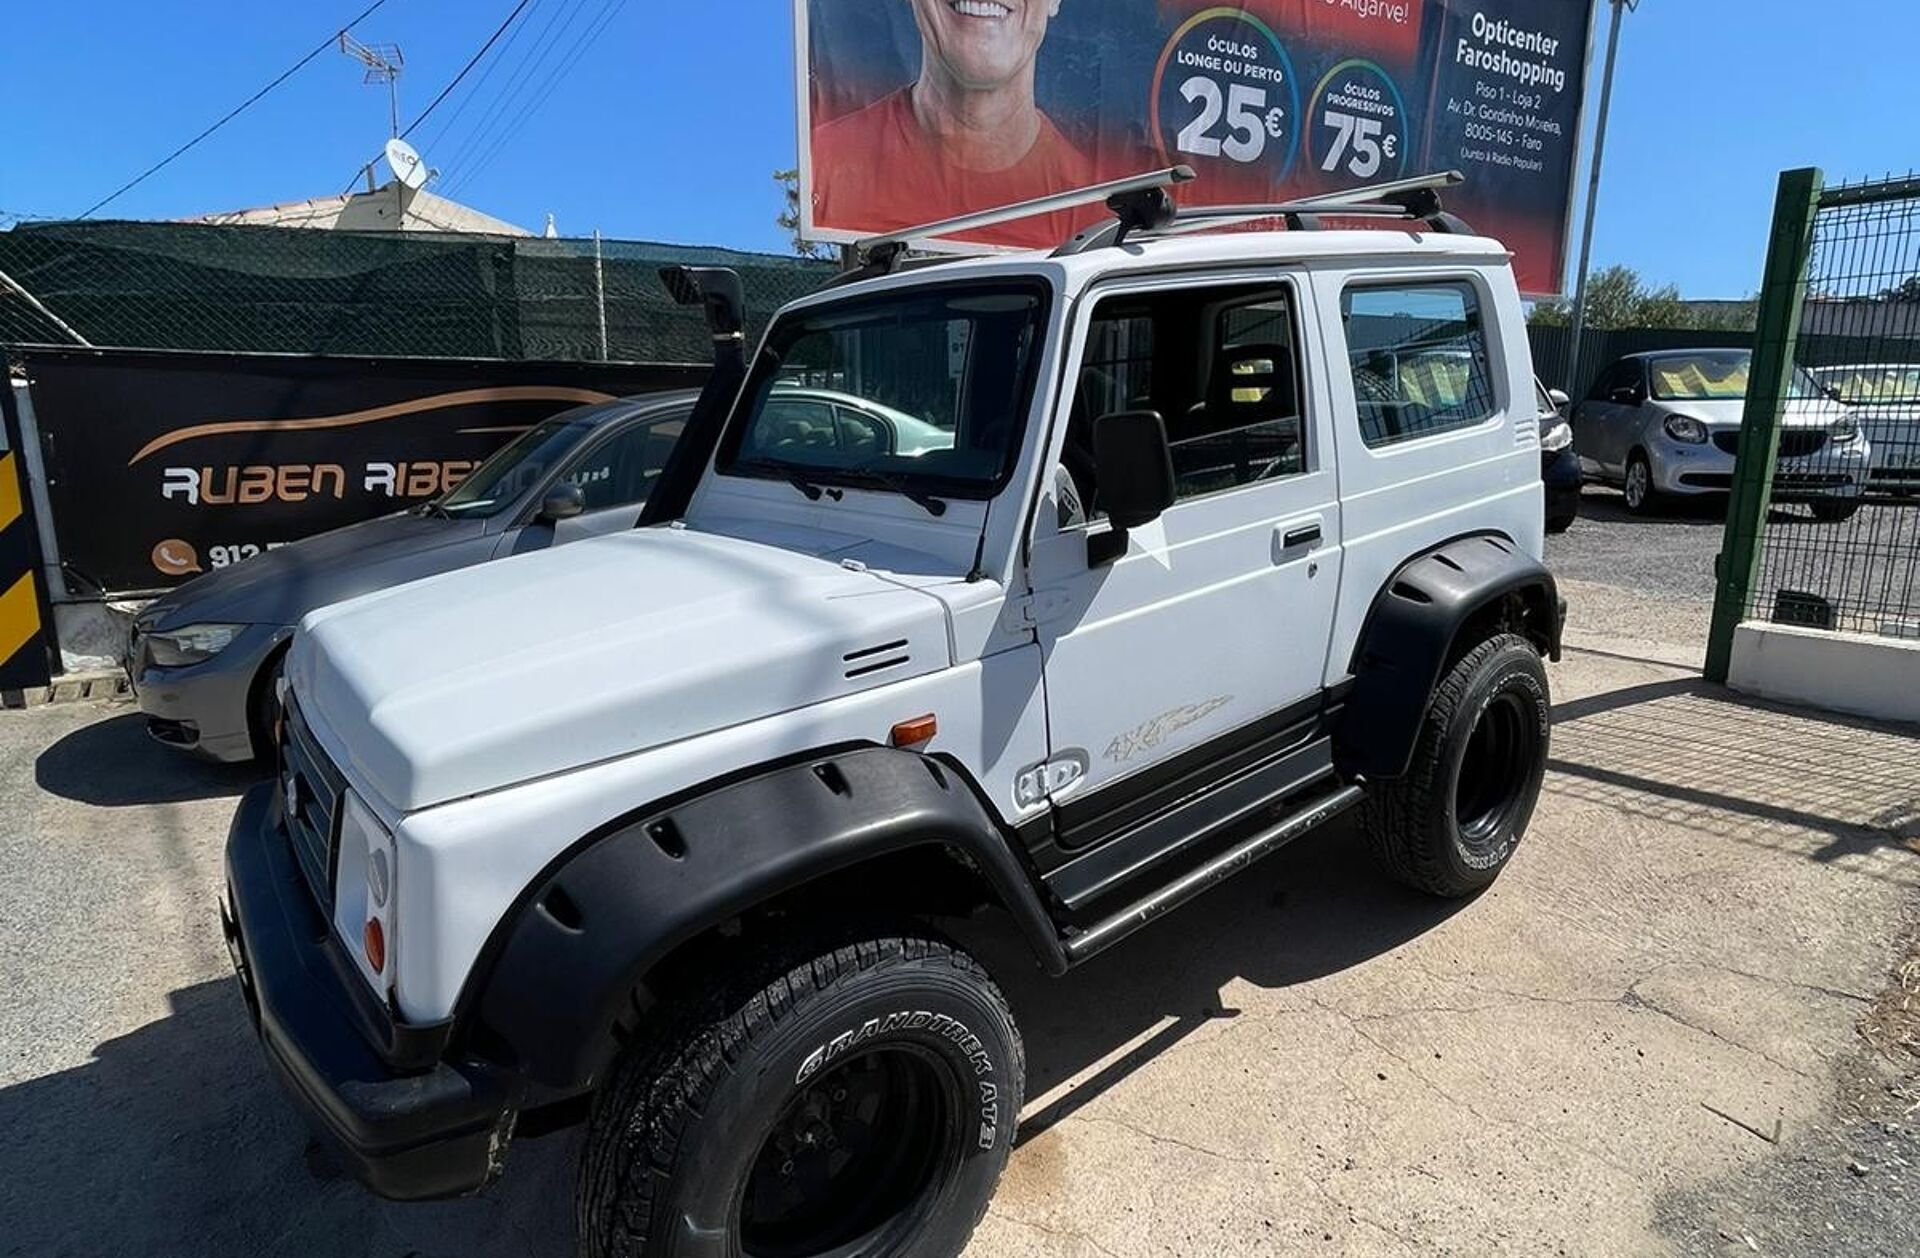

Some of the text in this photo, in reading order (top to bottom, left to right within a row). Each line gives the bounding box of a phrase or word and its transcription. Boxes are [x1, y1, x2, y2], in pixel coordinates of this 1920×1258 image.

[1207, 34, 1258, 60] ÓCULOS
[1471, 12, 1560, 57] Opticenter
[1177, 50, 1283, 83] LONGE OU PERTO
[1456, 38, 1565, 93] Faroshopping
[1327, 92, 1395, 117] PROGRESSIVOS
[1344, 80, 1380, 101] ÓCULOS
[1447, 97, 1462, 114] Av.
[1476, 81, 1497, 99] Piso
[1513, 90, 1532, 109] Loja
[1534, 94, 1542, 109] 2
[1176, 76, 1285, 163] 25€
[1321, 110, 1397, 179] 75€
[1465, 122, 1513, 145] 8005-145
[1521, 133, 1543, 151] Faro
[162, 460, 483, 505] RUBEN RIBE
[795, 1010, 1000, 1151] GRANDTREK AT3
